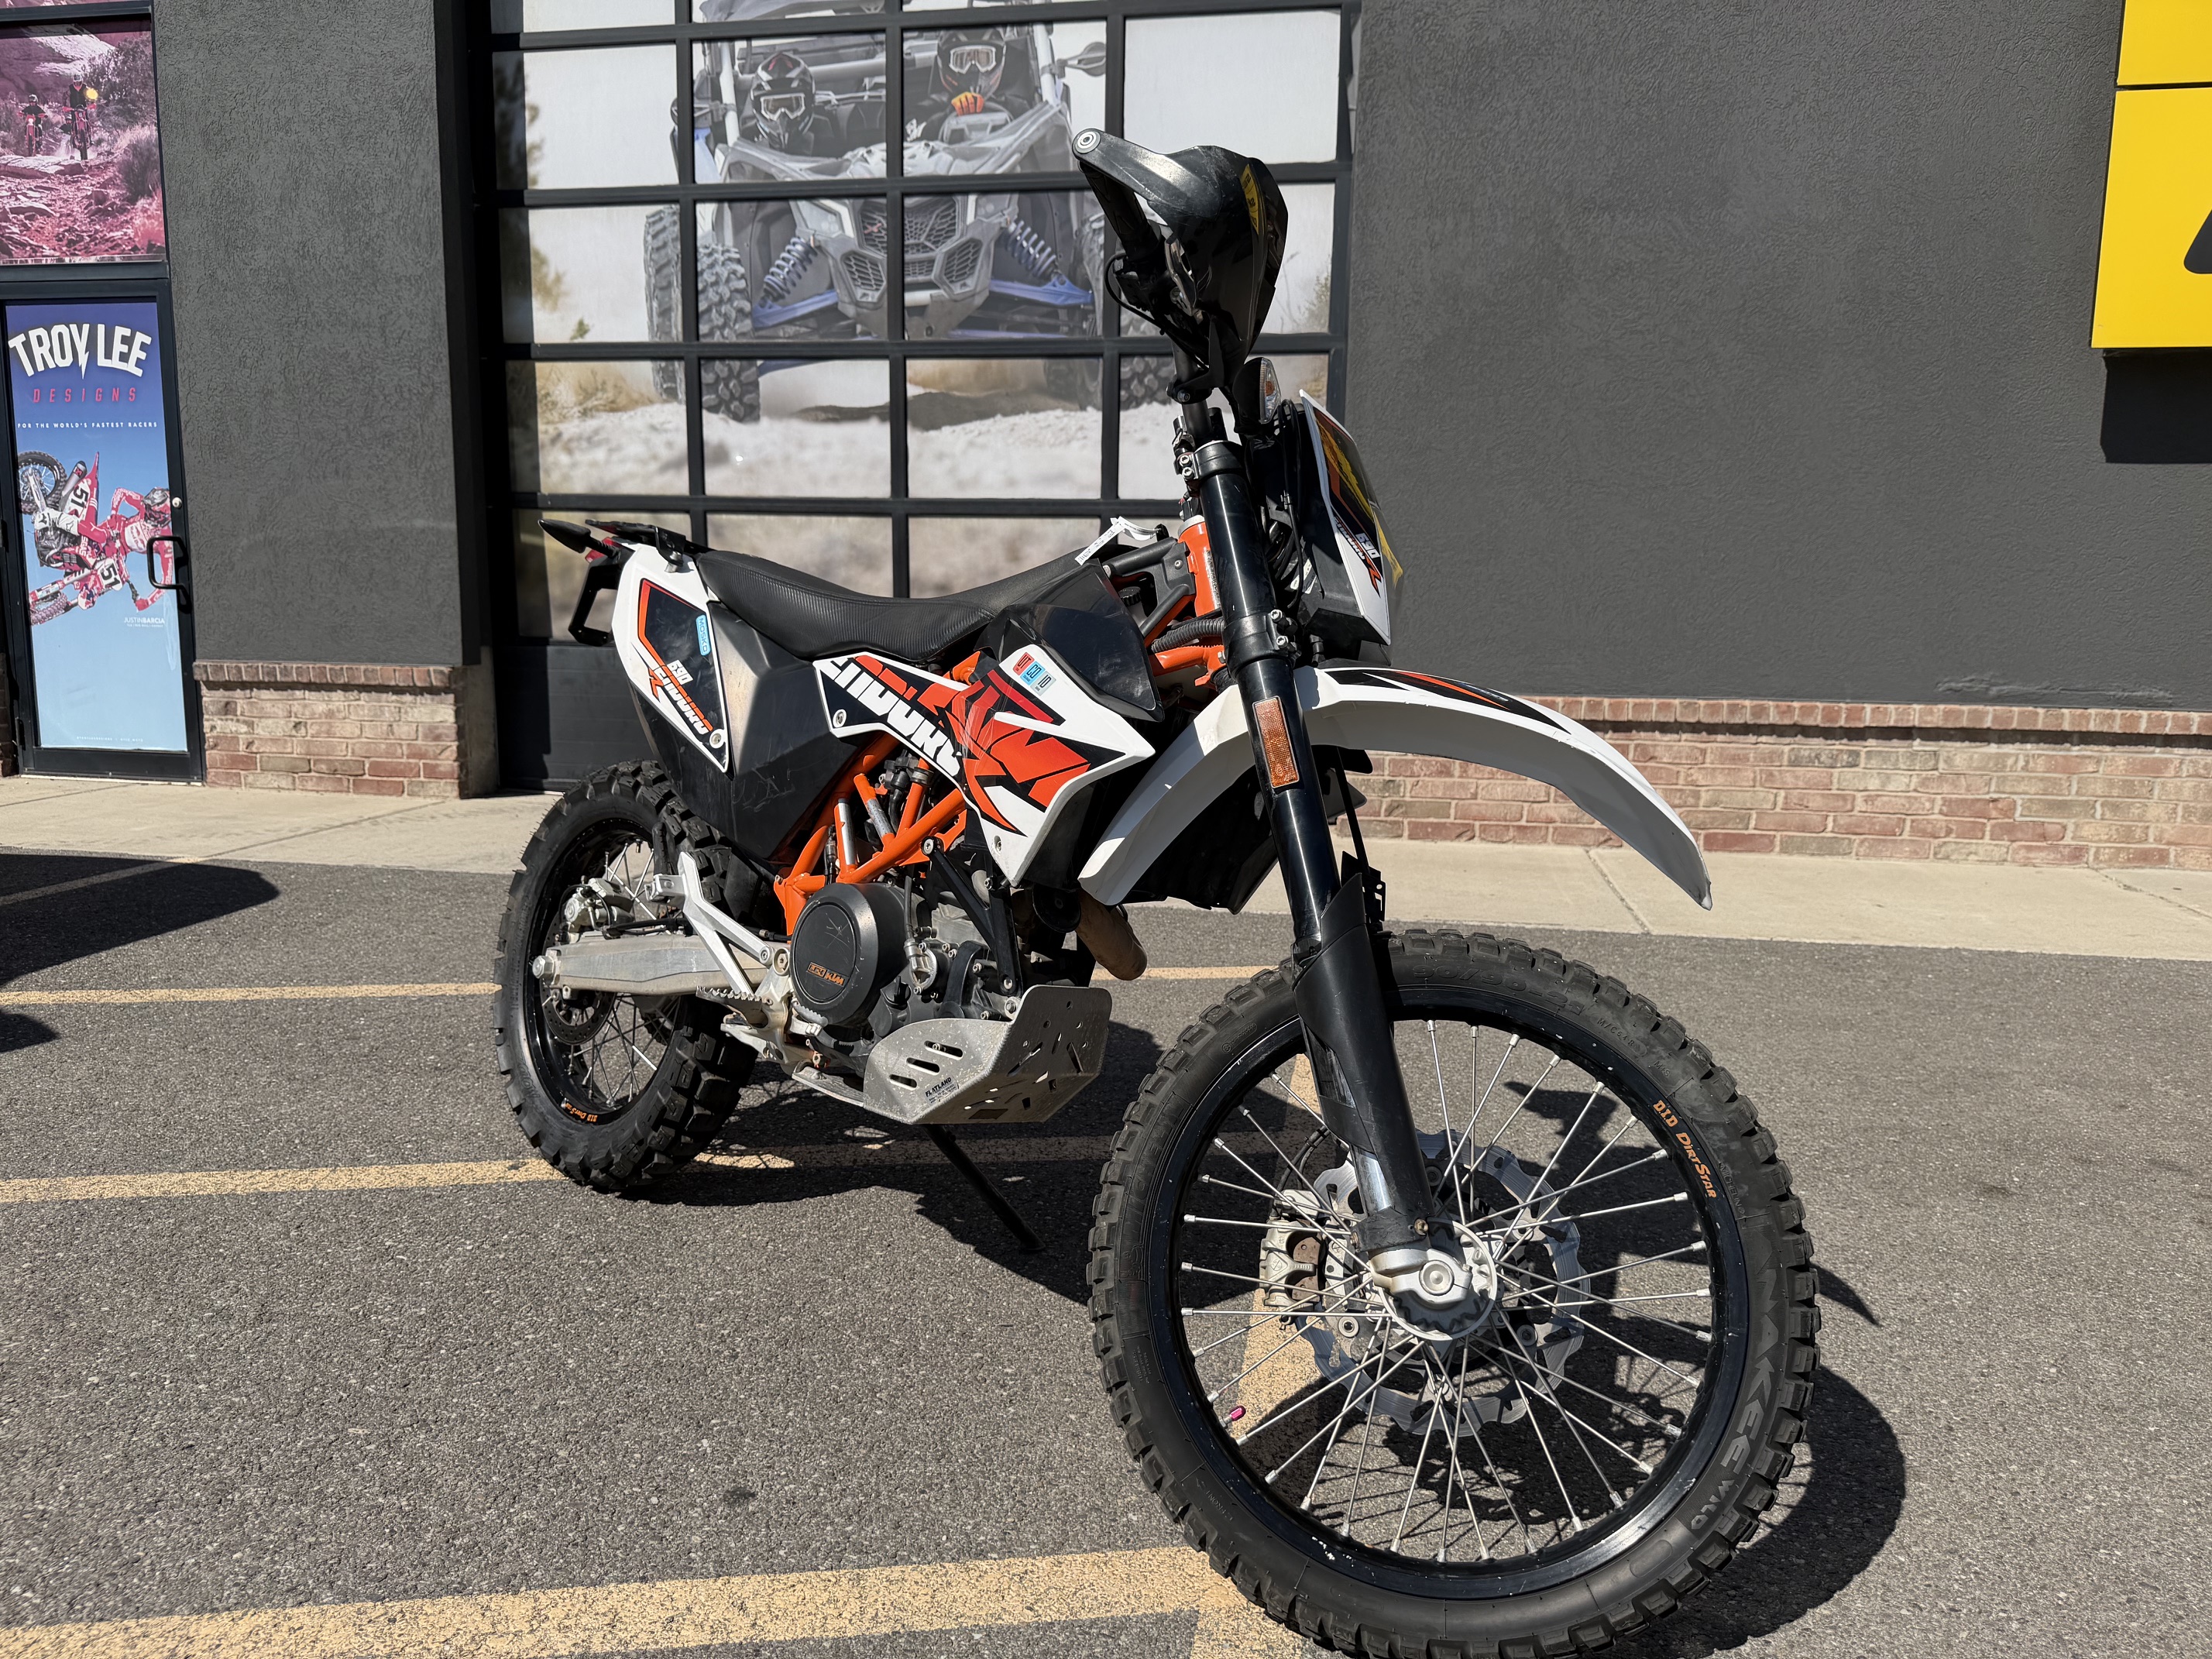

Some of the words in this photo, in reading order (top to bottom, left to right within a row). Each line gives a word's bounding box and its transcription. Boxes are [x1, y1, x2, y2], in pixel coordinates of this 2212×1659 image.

[8, 324, 90, 380] TROY
[98, 324, 152, 377] LEE
[33, 387, 136, 403] DESIGNS
[70, 487, 89, 510] 51
[1355, 532, 1381, 559] 690
[100, 565, 121, 586] 51
[698, 617, 709, 654] MOSKO
[666, 659, 694, 685] 690
[1017, 654, 1032, 669] UT
[1026, 663, 1042, 678] CO
[1038, 674, 1053, 689] ID
[653, 665, 714, 735] ENDURO
[1413, 964, 1585, 1015] 90/90-21
[925, 1077, 952, 1097] FLATLAND
[1692, 1480, 1735, 1529] WILD
